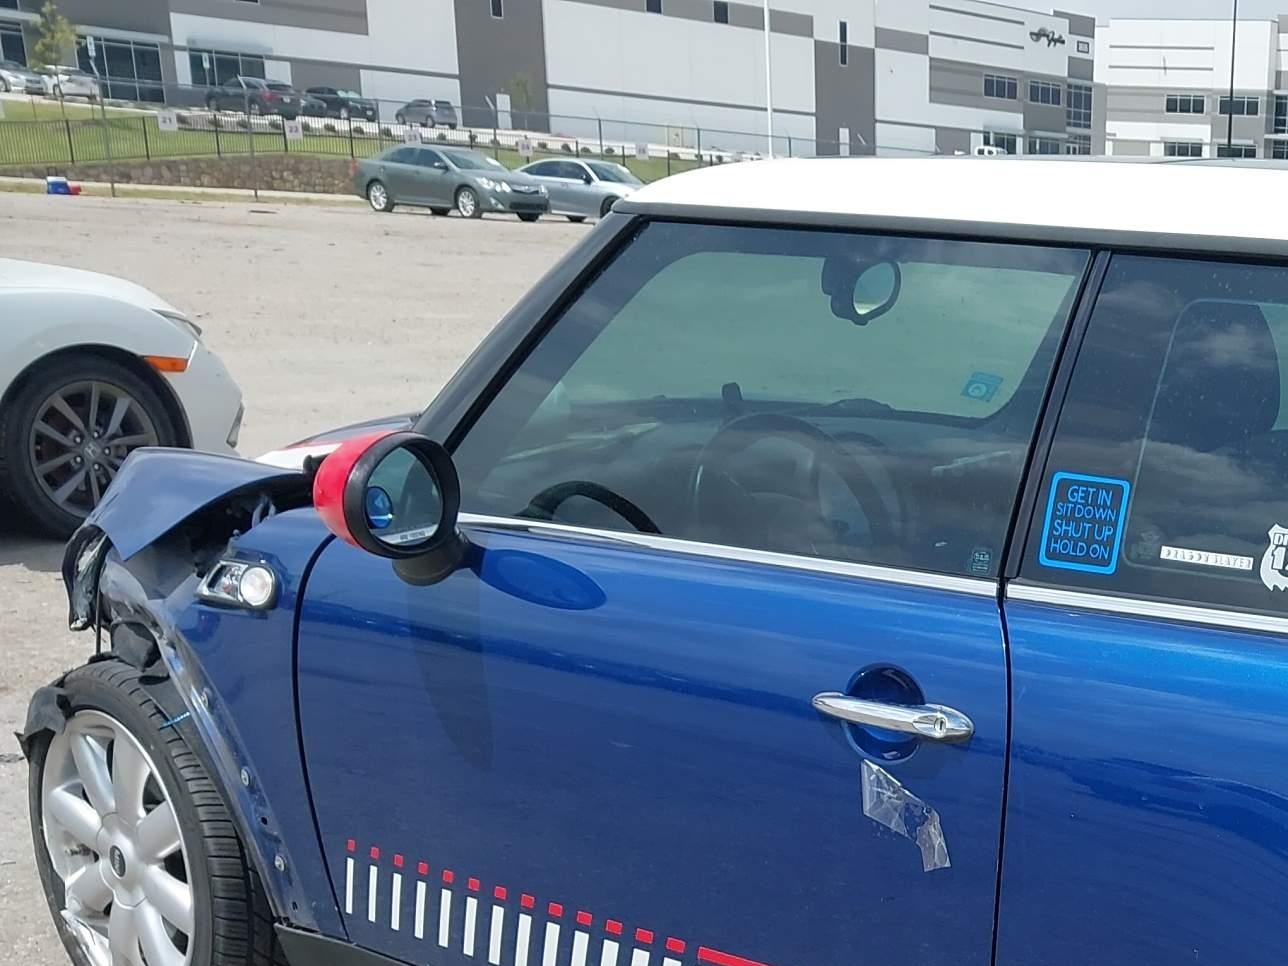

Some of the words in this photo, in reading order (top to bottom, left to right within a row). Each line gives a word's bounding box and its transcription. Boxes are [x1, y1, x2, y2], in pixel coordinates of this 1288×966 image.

[1067, 485, 1097, 504] GET
[1097, 488, 1113, 507] IN
[1056, 502, 1075, 517] SIT
[1075, 504, 1117, 522] DOWN
[1053, 519, 1093, 539] SHUT
[1094, 524, 1114, 542] UP
[1050, 538, 1087, 556] HOLD
[1089, 543, 1110, 560] ON
